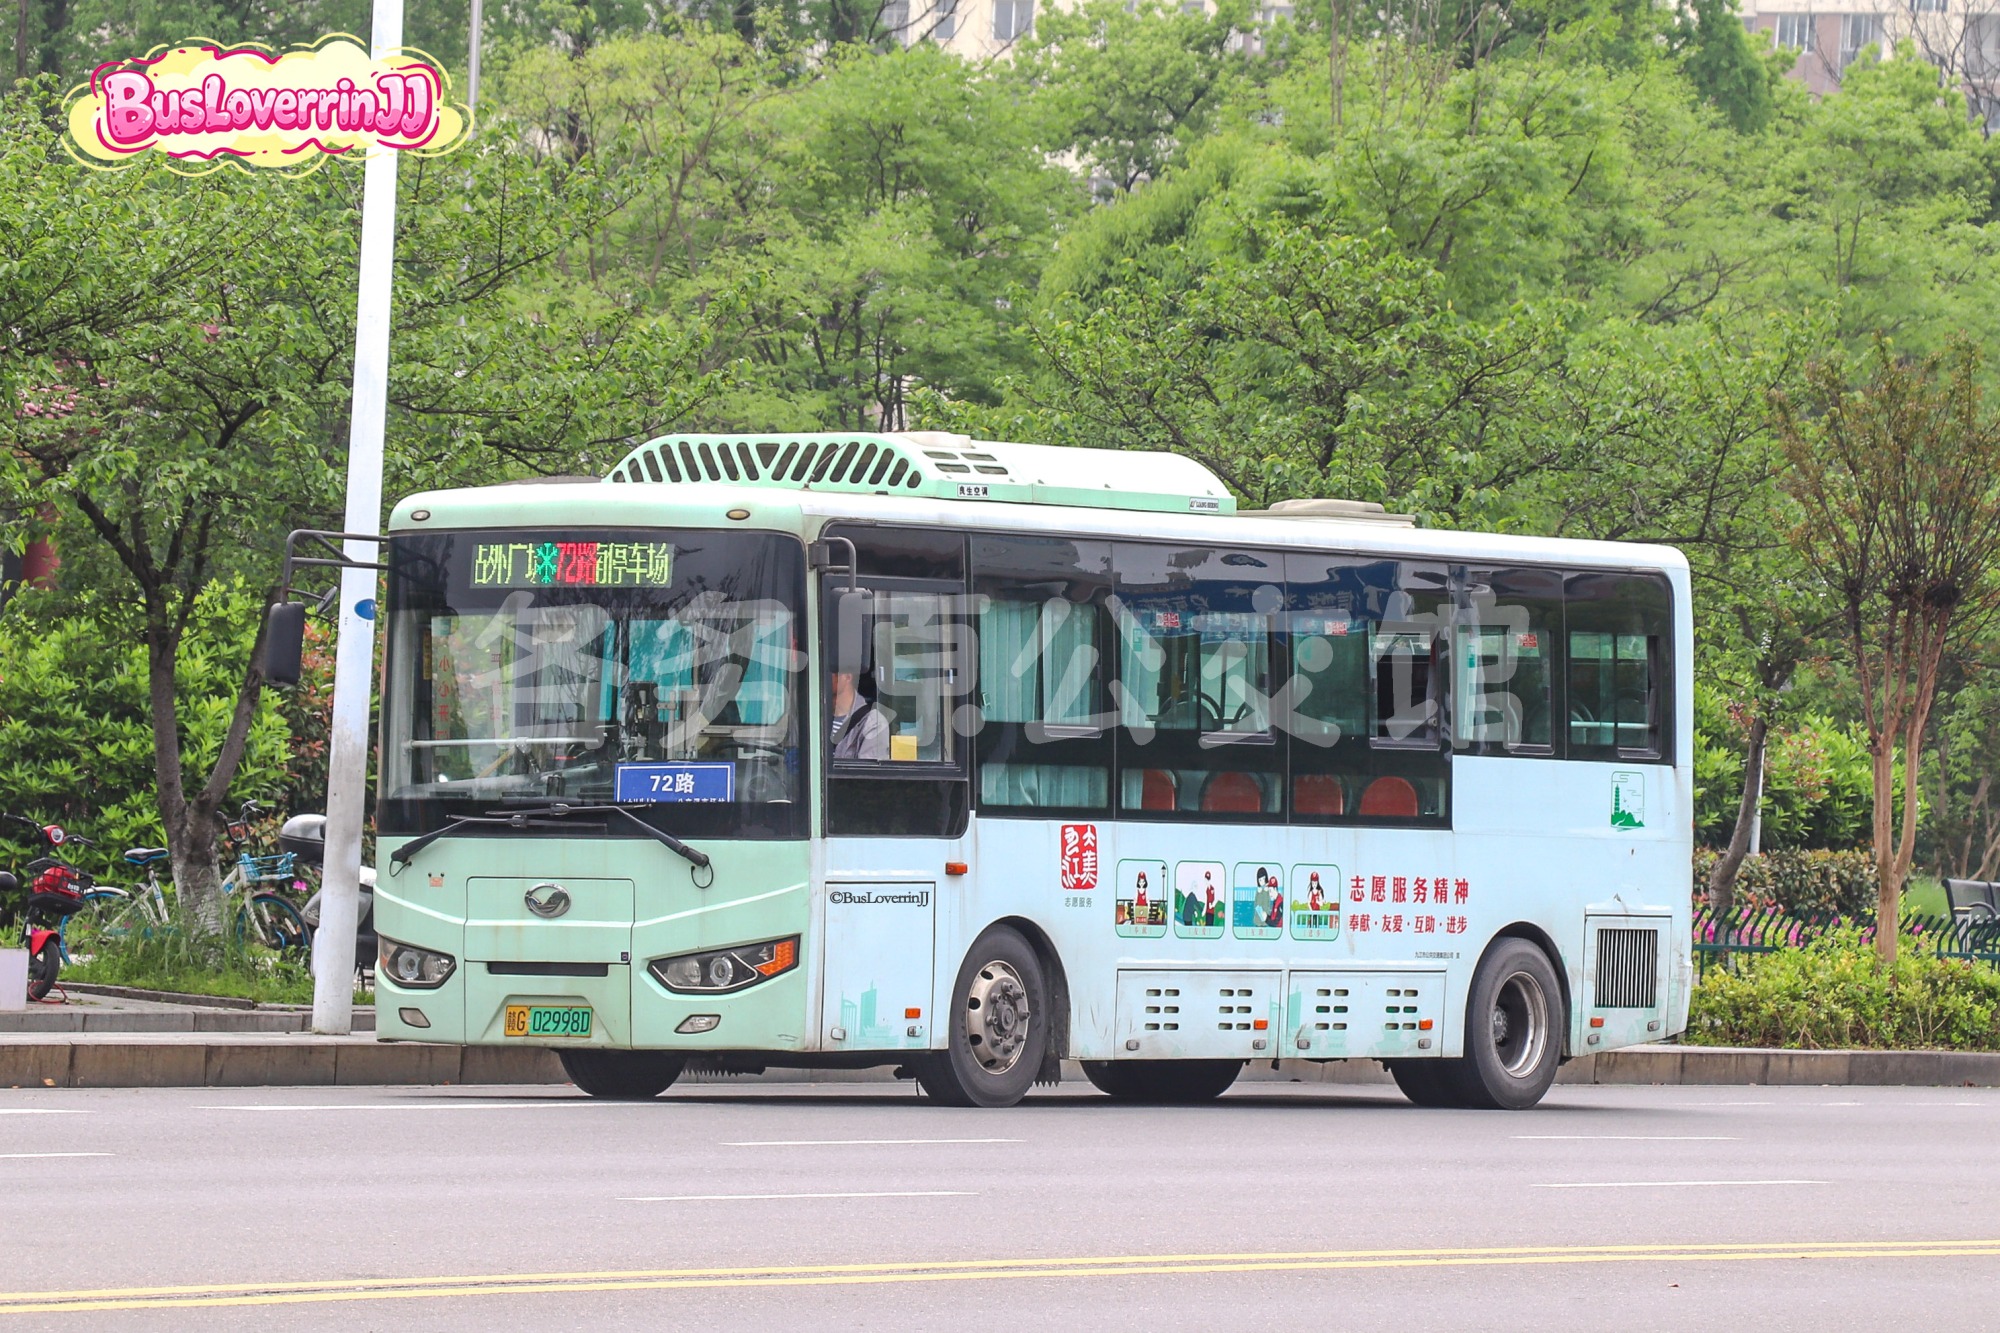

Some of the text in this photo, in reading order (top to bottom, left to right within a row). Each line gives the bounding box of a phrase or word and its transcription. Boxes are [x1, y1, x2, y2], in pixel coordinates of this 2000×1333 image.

[650, 772, 695, 794] 72路
[1350, 875, 1469, 904] 志愿服务精神
